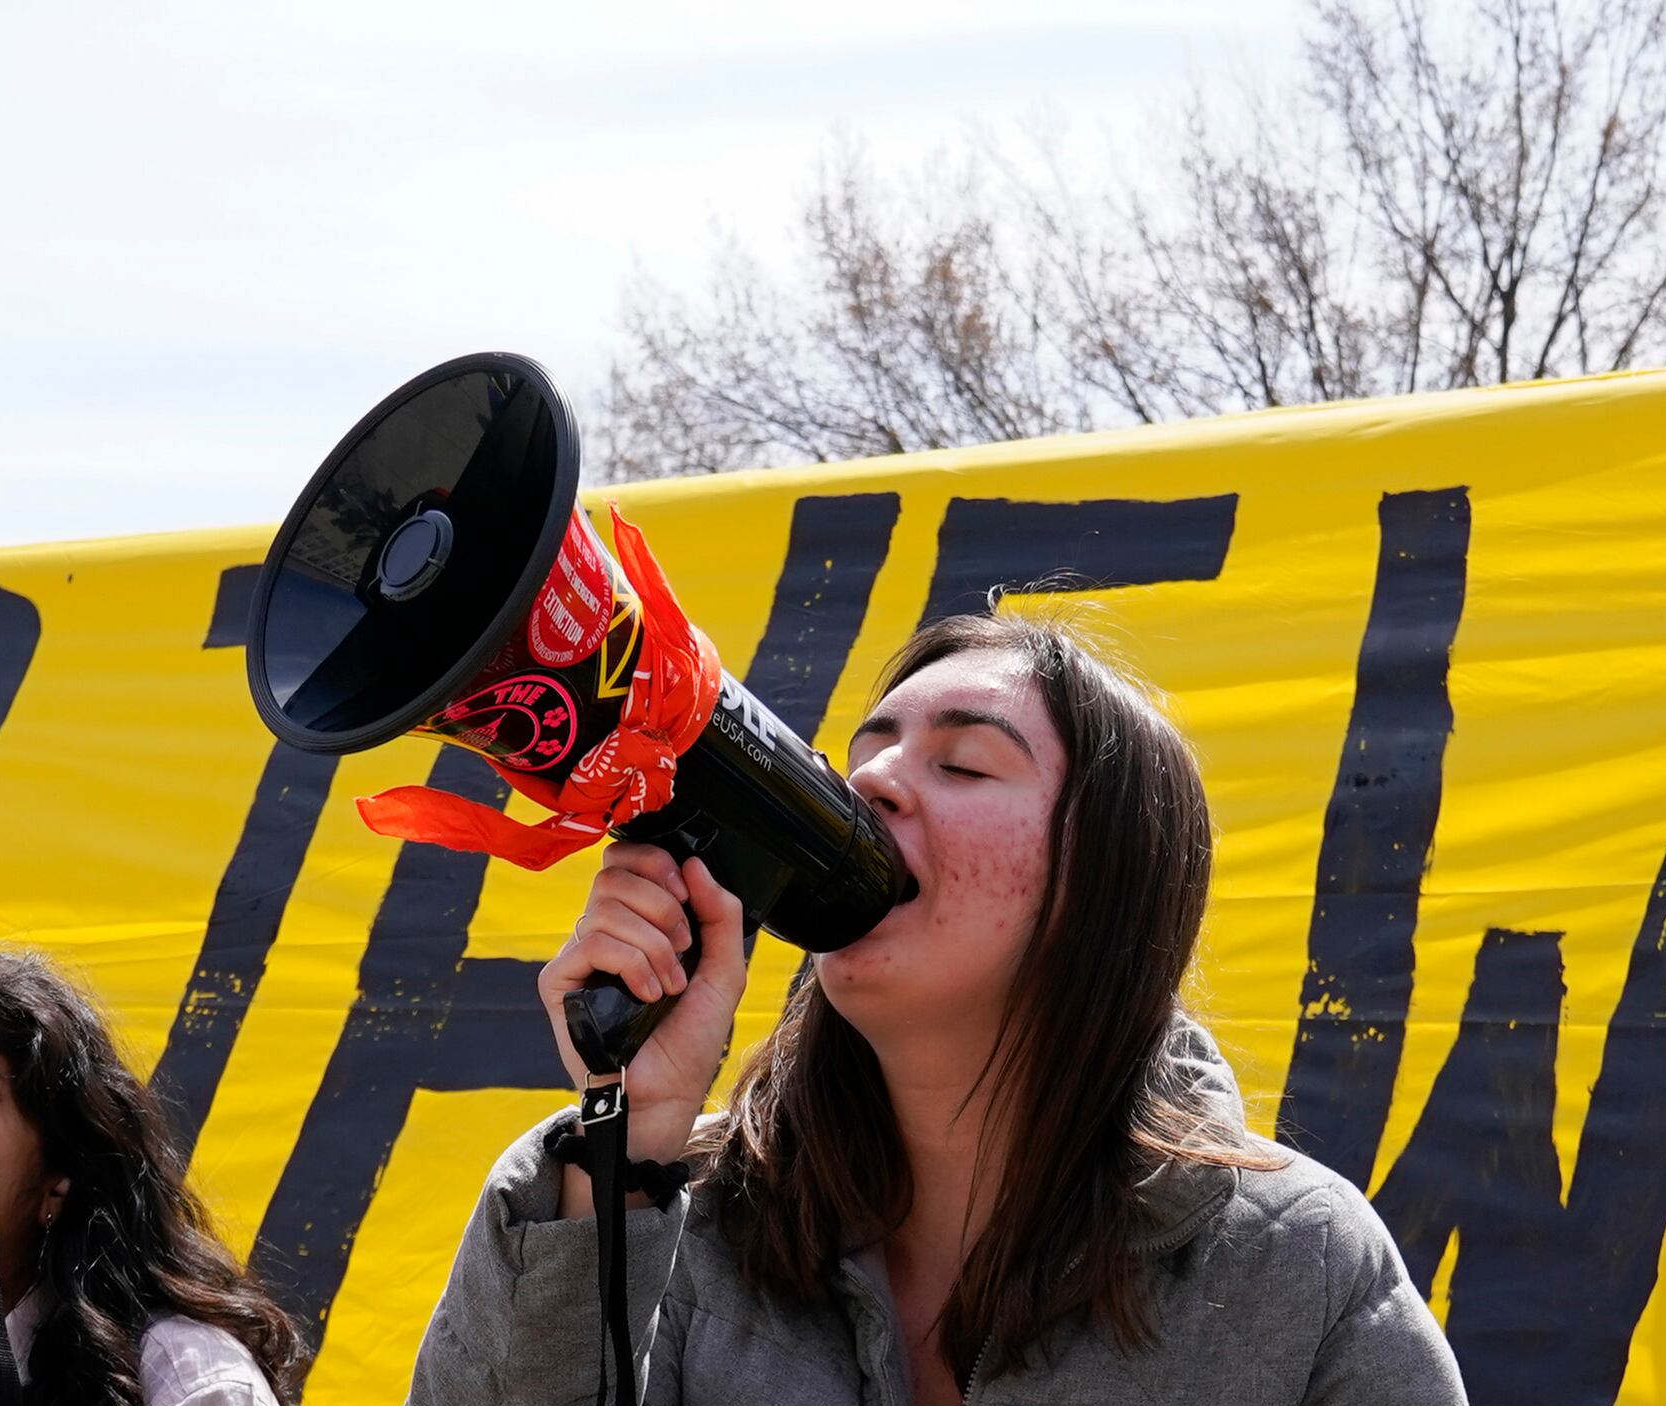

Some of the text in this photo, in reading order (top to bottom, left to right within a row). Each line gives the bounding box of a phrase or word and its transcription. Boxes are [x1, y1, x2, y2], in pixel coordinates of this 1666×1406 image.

[543, 588, 584, 646] EXTINCTION
[571, 572, 602, 615] EMERGENCY
[494, 683, 547, 706] THE
[722, 676, 777, 752] YLE
[710, 712, 773, 772] eUSA.com
